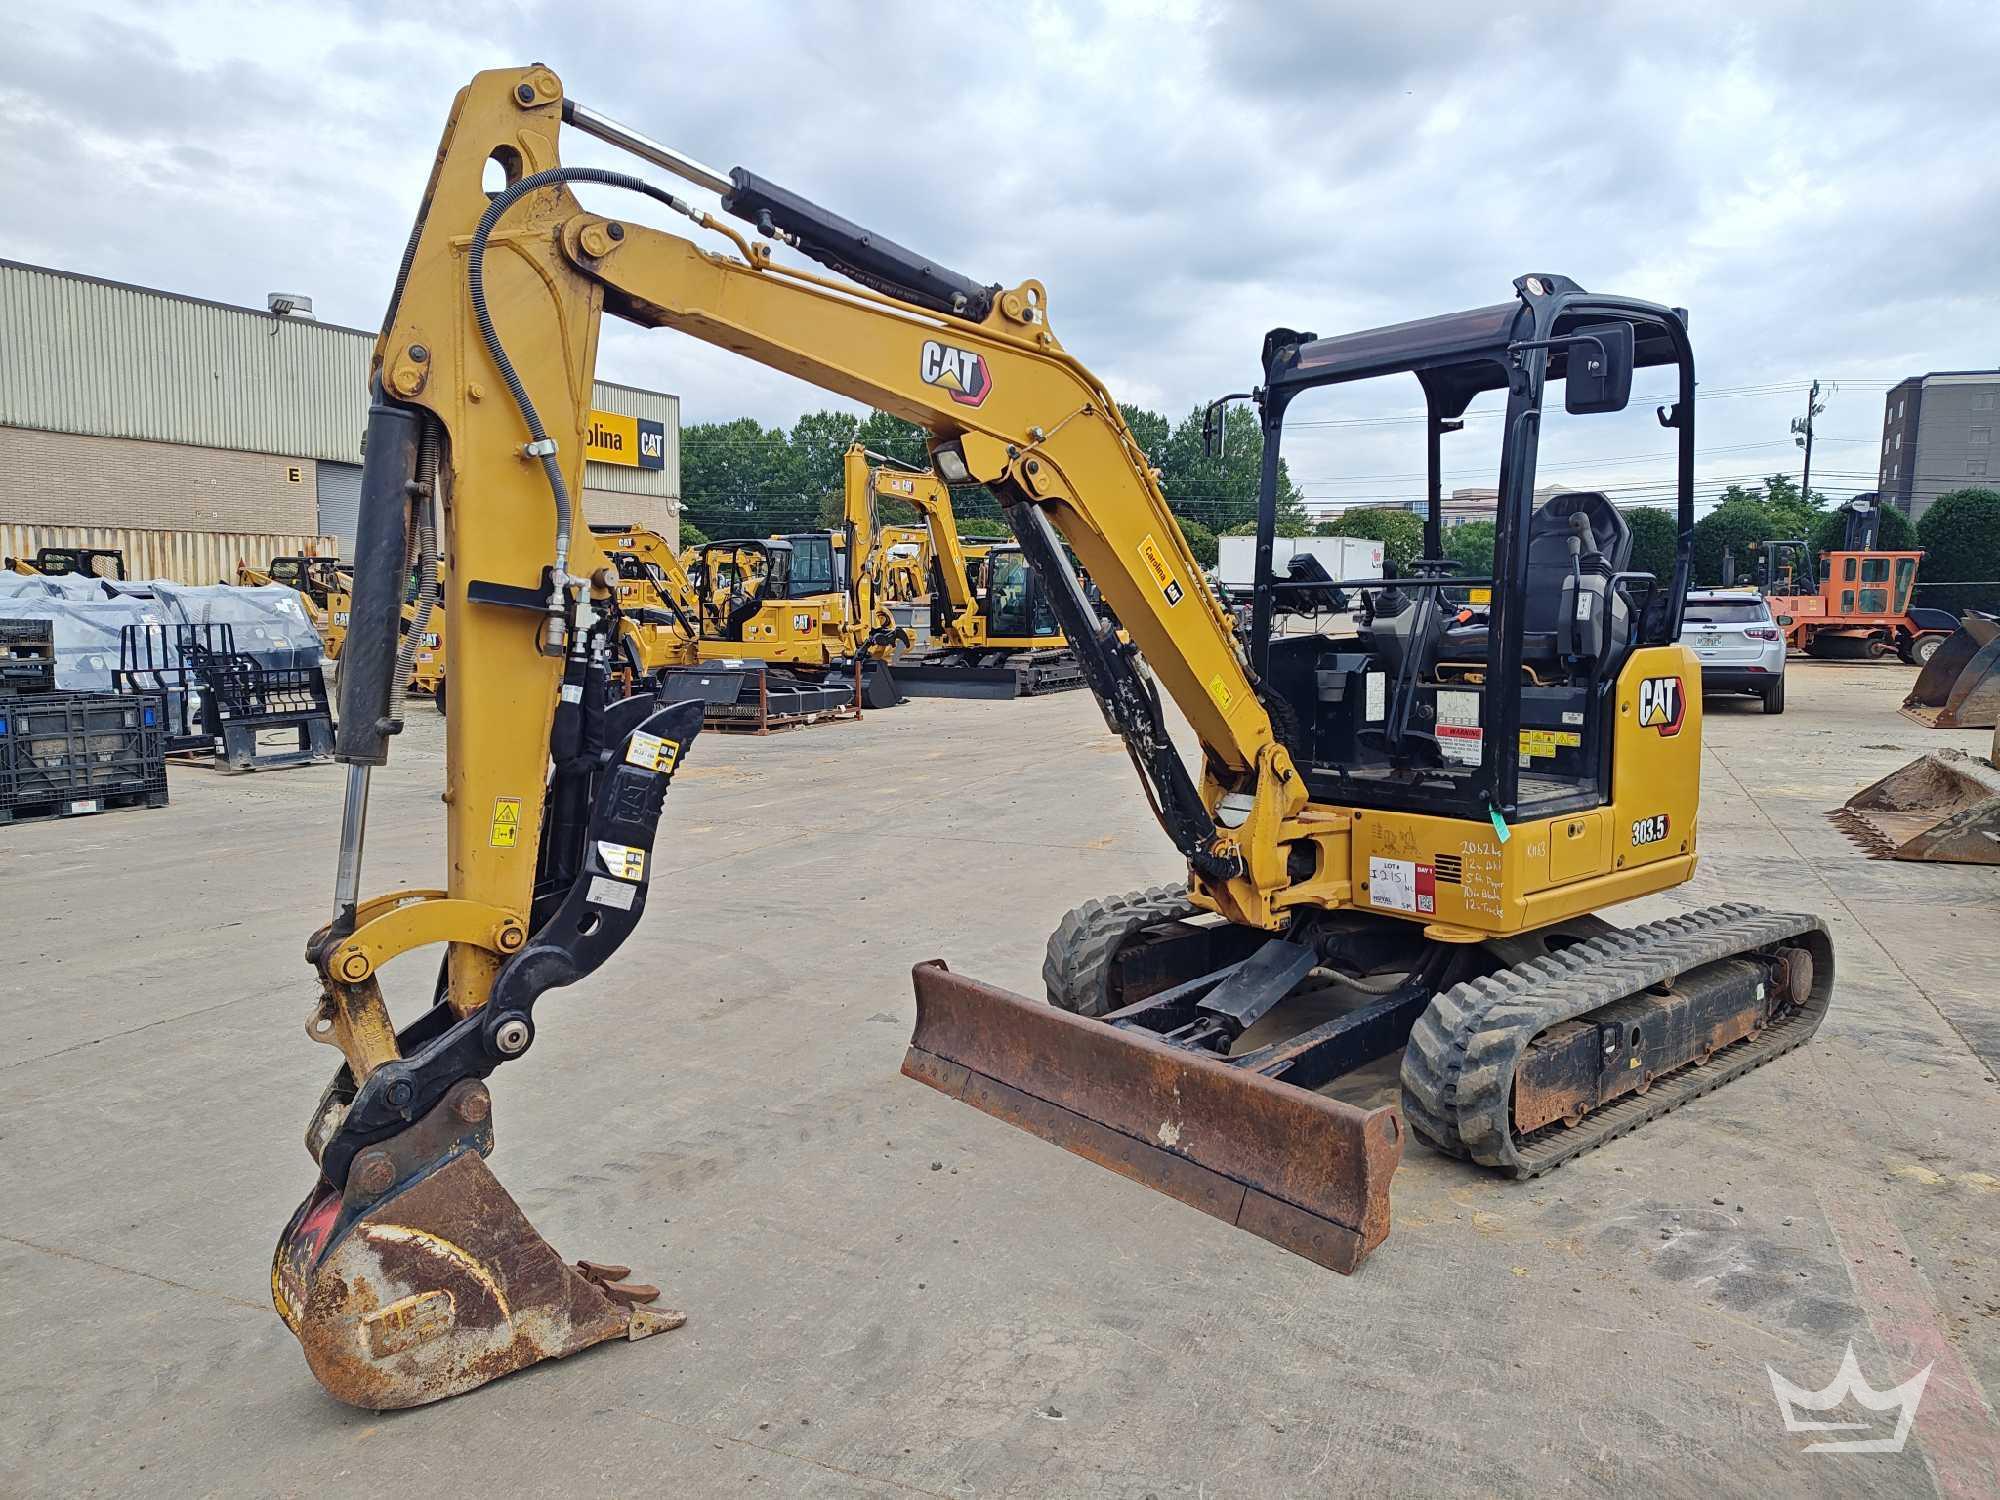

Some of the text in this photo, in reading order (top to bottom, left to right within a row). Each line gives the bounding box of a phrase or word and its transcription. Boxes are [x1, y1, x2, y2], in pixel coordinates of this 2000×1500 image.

[921, 340, 979, 394] CAT
[641, 431, 663, 458] CAT
[289, 468, 300, 482] E
[1145, 546, 1167, 582] Carolina
[793, 614, 809, 630] CAT
[1639, 678, 1676, 727] CAT
[1449, 728, 1480, 738] WARNING
[1632, 814, 1666, 846] 303.5
